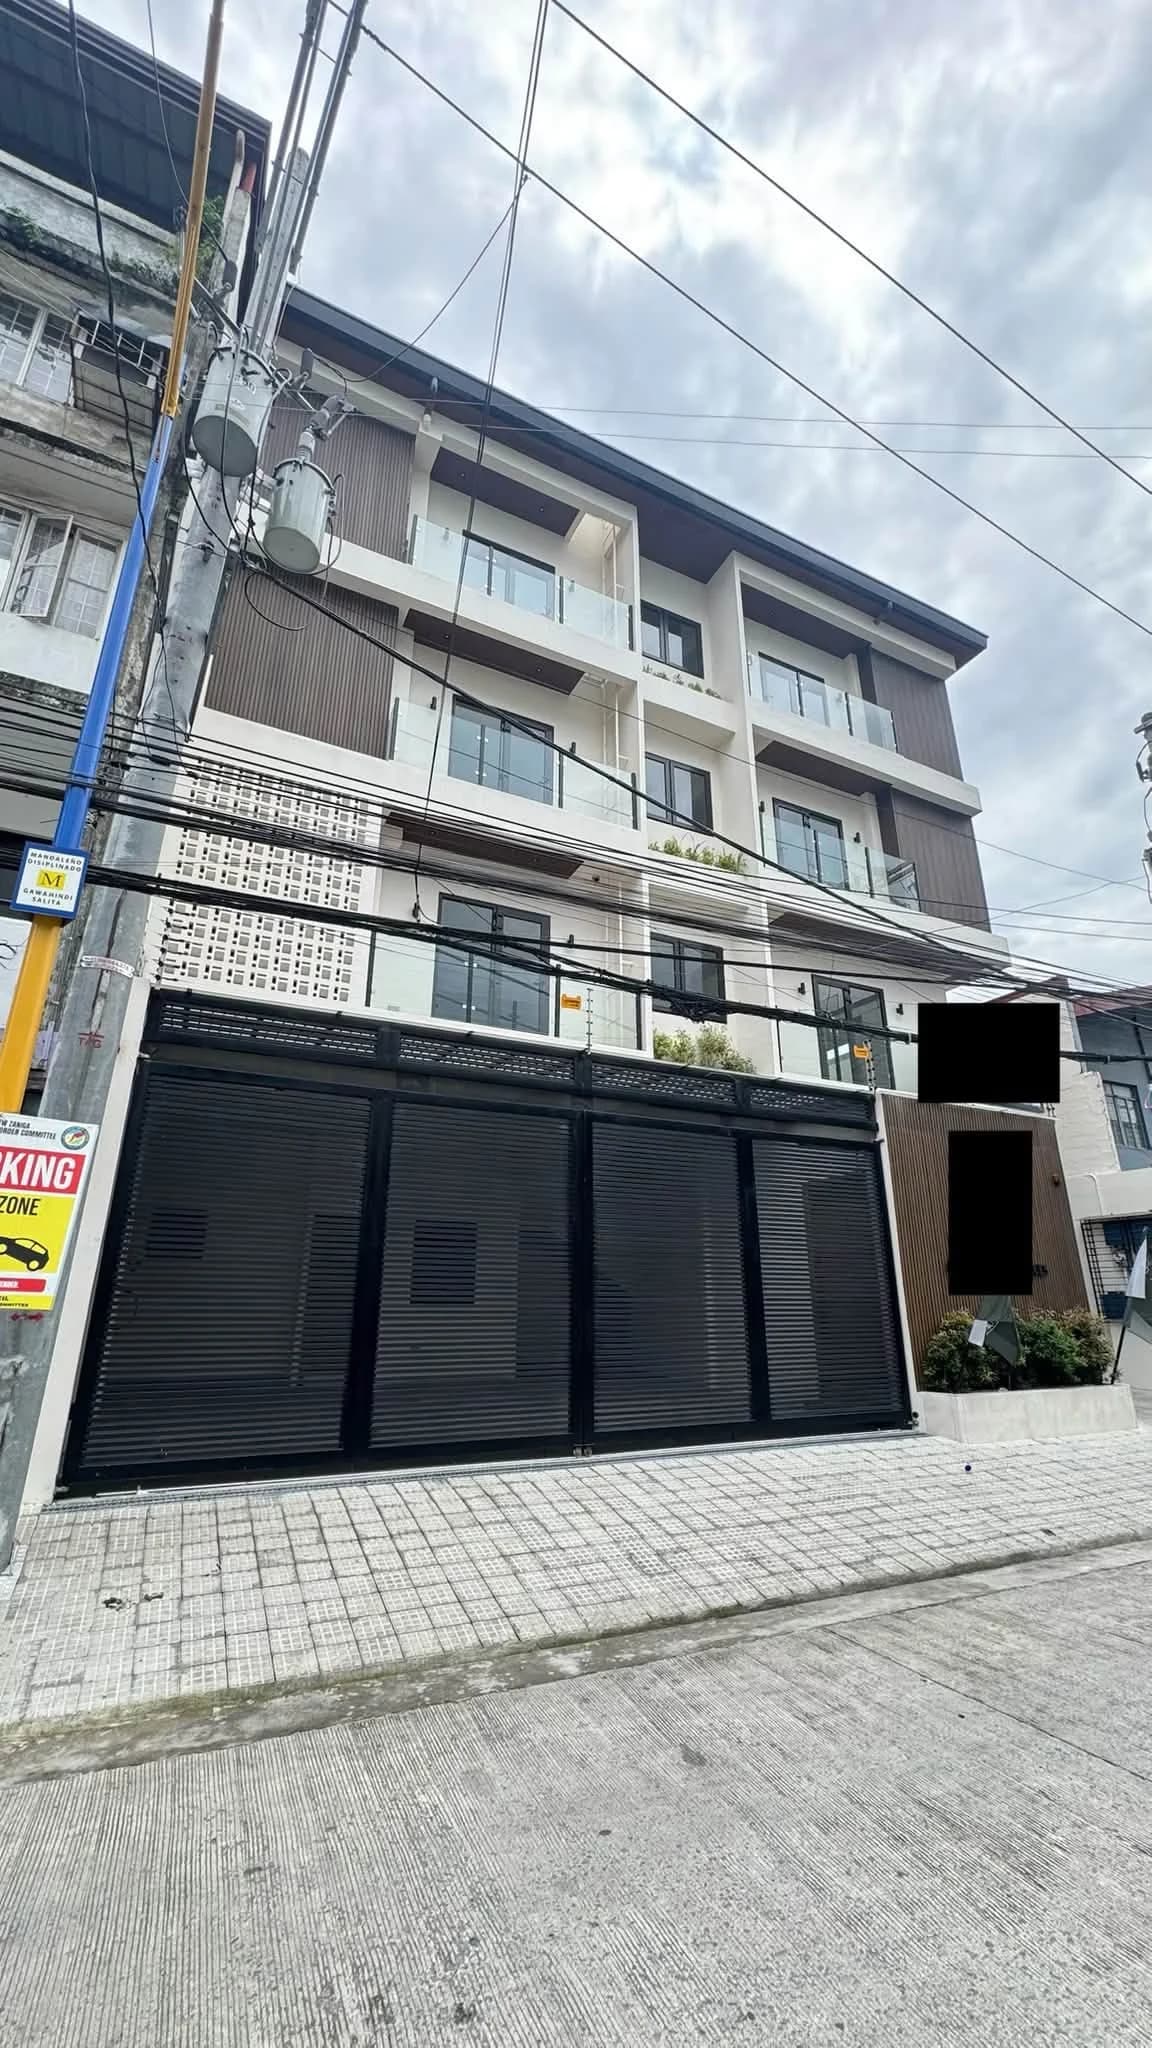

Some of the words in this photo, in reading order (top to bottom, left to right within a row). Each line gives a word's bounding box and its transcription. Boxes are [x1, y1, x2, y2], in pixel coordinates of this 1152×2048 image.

[28, 858, 82, 872] DISIPLINADO
[40, 872, 63, 887] M
[32, 896, 61, 905] SALITA
[0, 1151, 76, 1190] KING
[0, 1195, 40, 1216] ZONE
